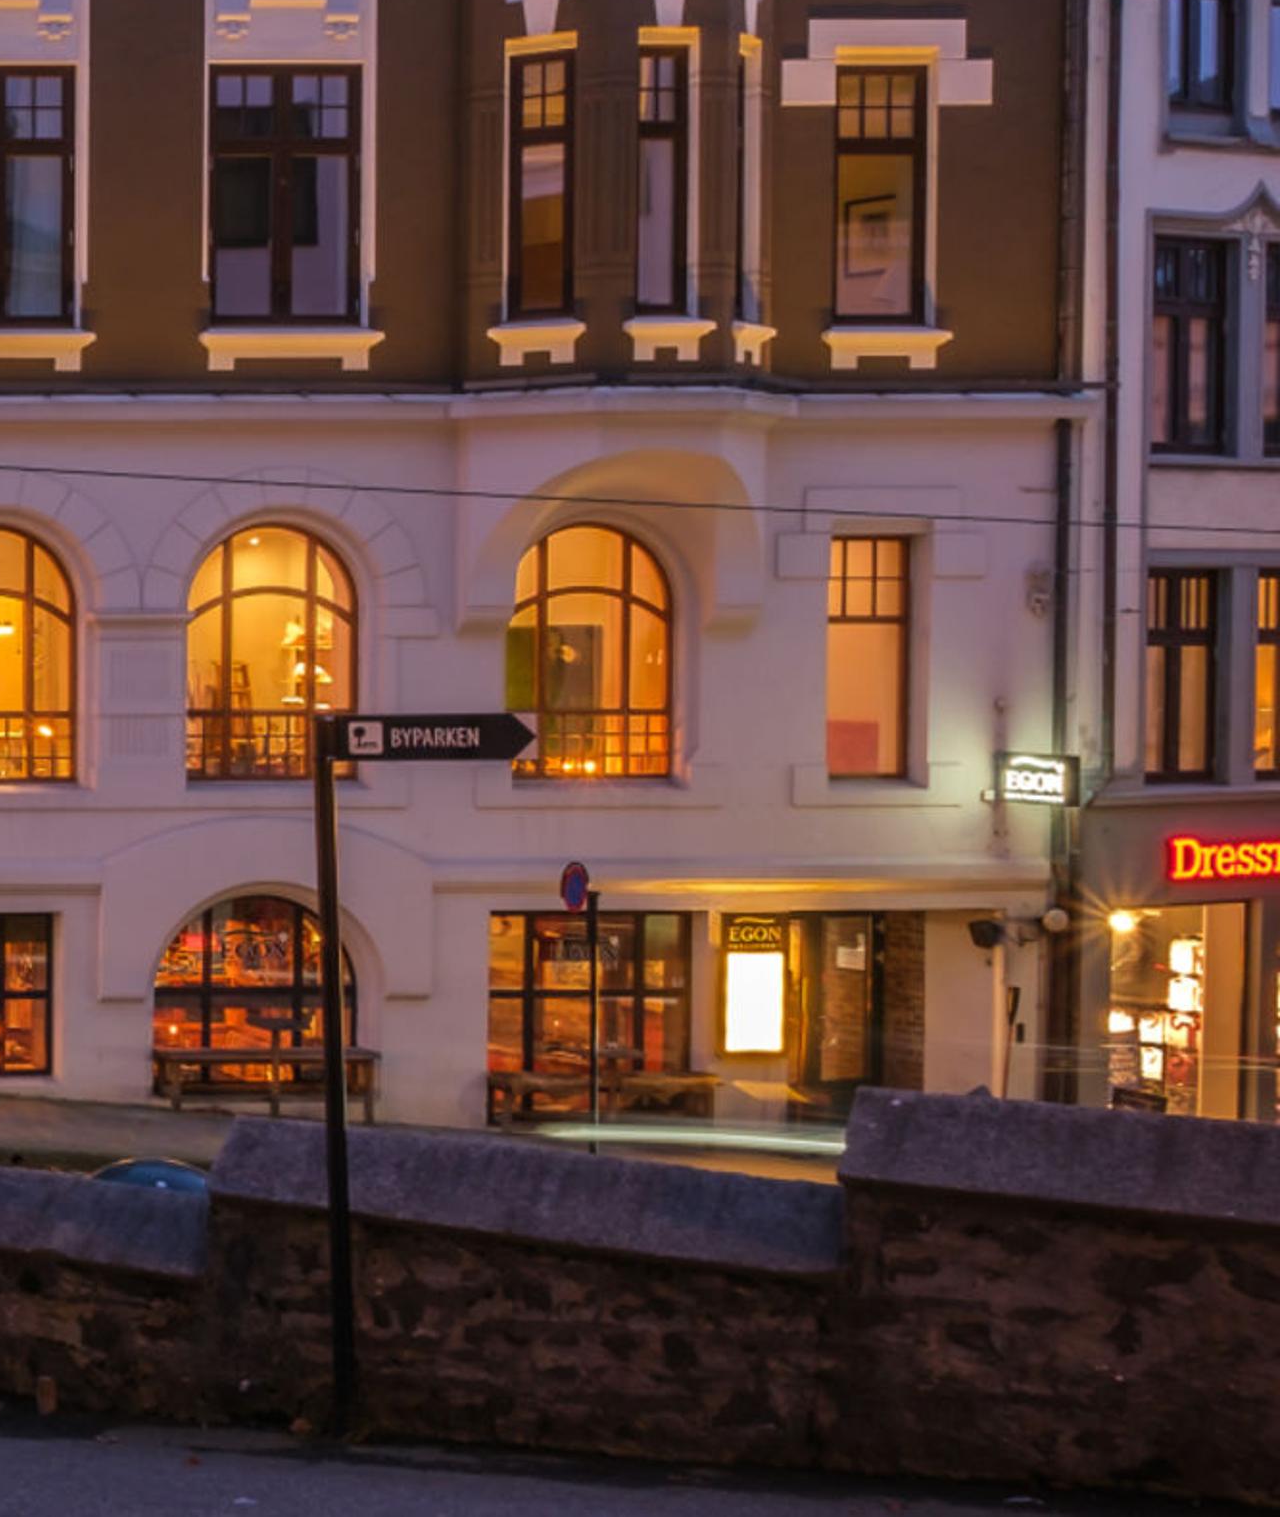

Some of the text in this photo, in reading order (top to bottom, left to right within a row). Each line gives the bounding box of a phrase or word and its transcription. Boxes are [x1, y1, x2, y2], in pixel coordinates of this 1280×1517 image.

[391, 727, 480, 748] BYPARKEN
[1005, 769, 1064, 795] EGON
[1172, 837, 1280, 879] Dress
[728, 925, 782, 943] EGON
